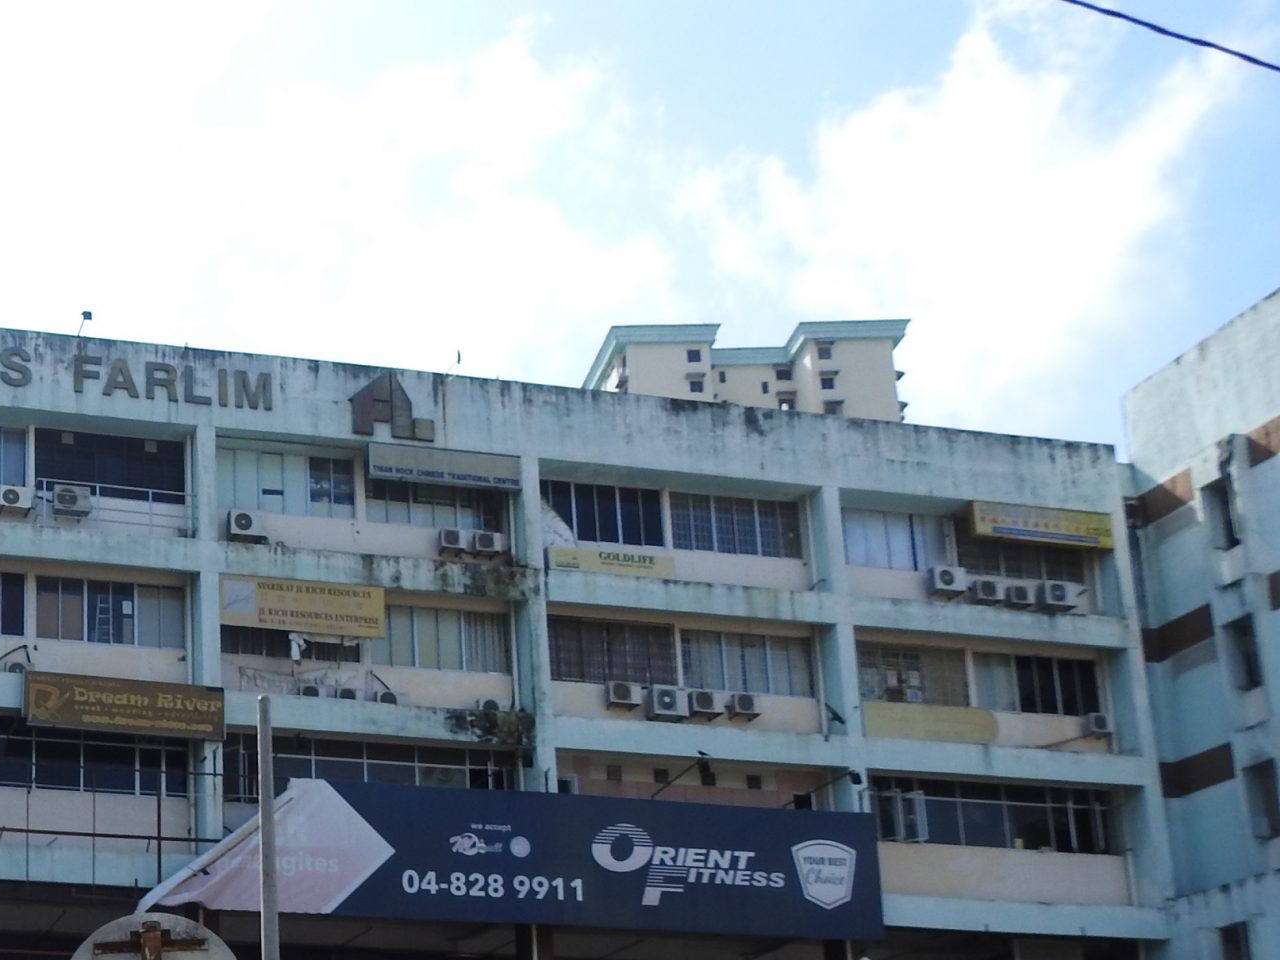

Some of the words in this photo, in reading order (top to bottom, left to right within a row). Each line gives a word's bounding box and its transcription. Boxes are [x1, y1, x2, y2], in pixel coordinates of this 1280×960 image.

[72, 354, 273, 412] FARLIM
[447, 472, 491, 484] TRADITIONAL
[493, 477, 520, 487] CENTRE
[598, 551, 657, 566] GOLDLIFE
[257, 582, 294, 593] SYARIKAT
[305, 585, 326, 596] RICH
[327, 587, 372, 600] RESOURCES
[268, 608, 288, 618] RICH
[290, 609, 334, 622] RESOURCES
[335, 612, 380, 626] ENTERPRISE
[73, 686, 150, 708] Dream
[157, 692, 223, 713] River
[470, 823, 484, 831] we
[484, 823, 512, 833] accept
[591, 823, 756, 873] ORIENT
[401, 868, 505, 898] 04-828
[512, 874, 584, 901] 9911
[641, 864, 786, 906] FITNESS
